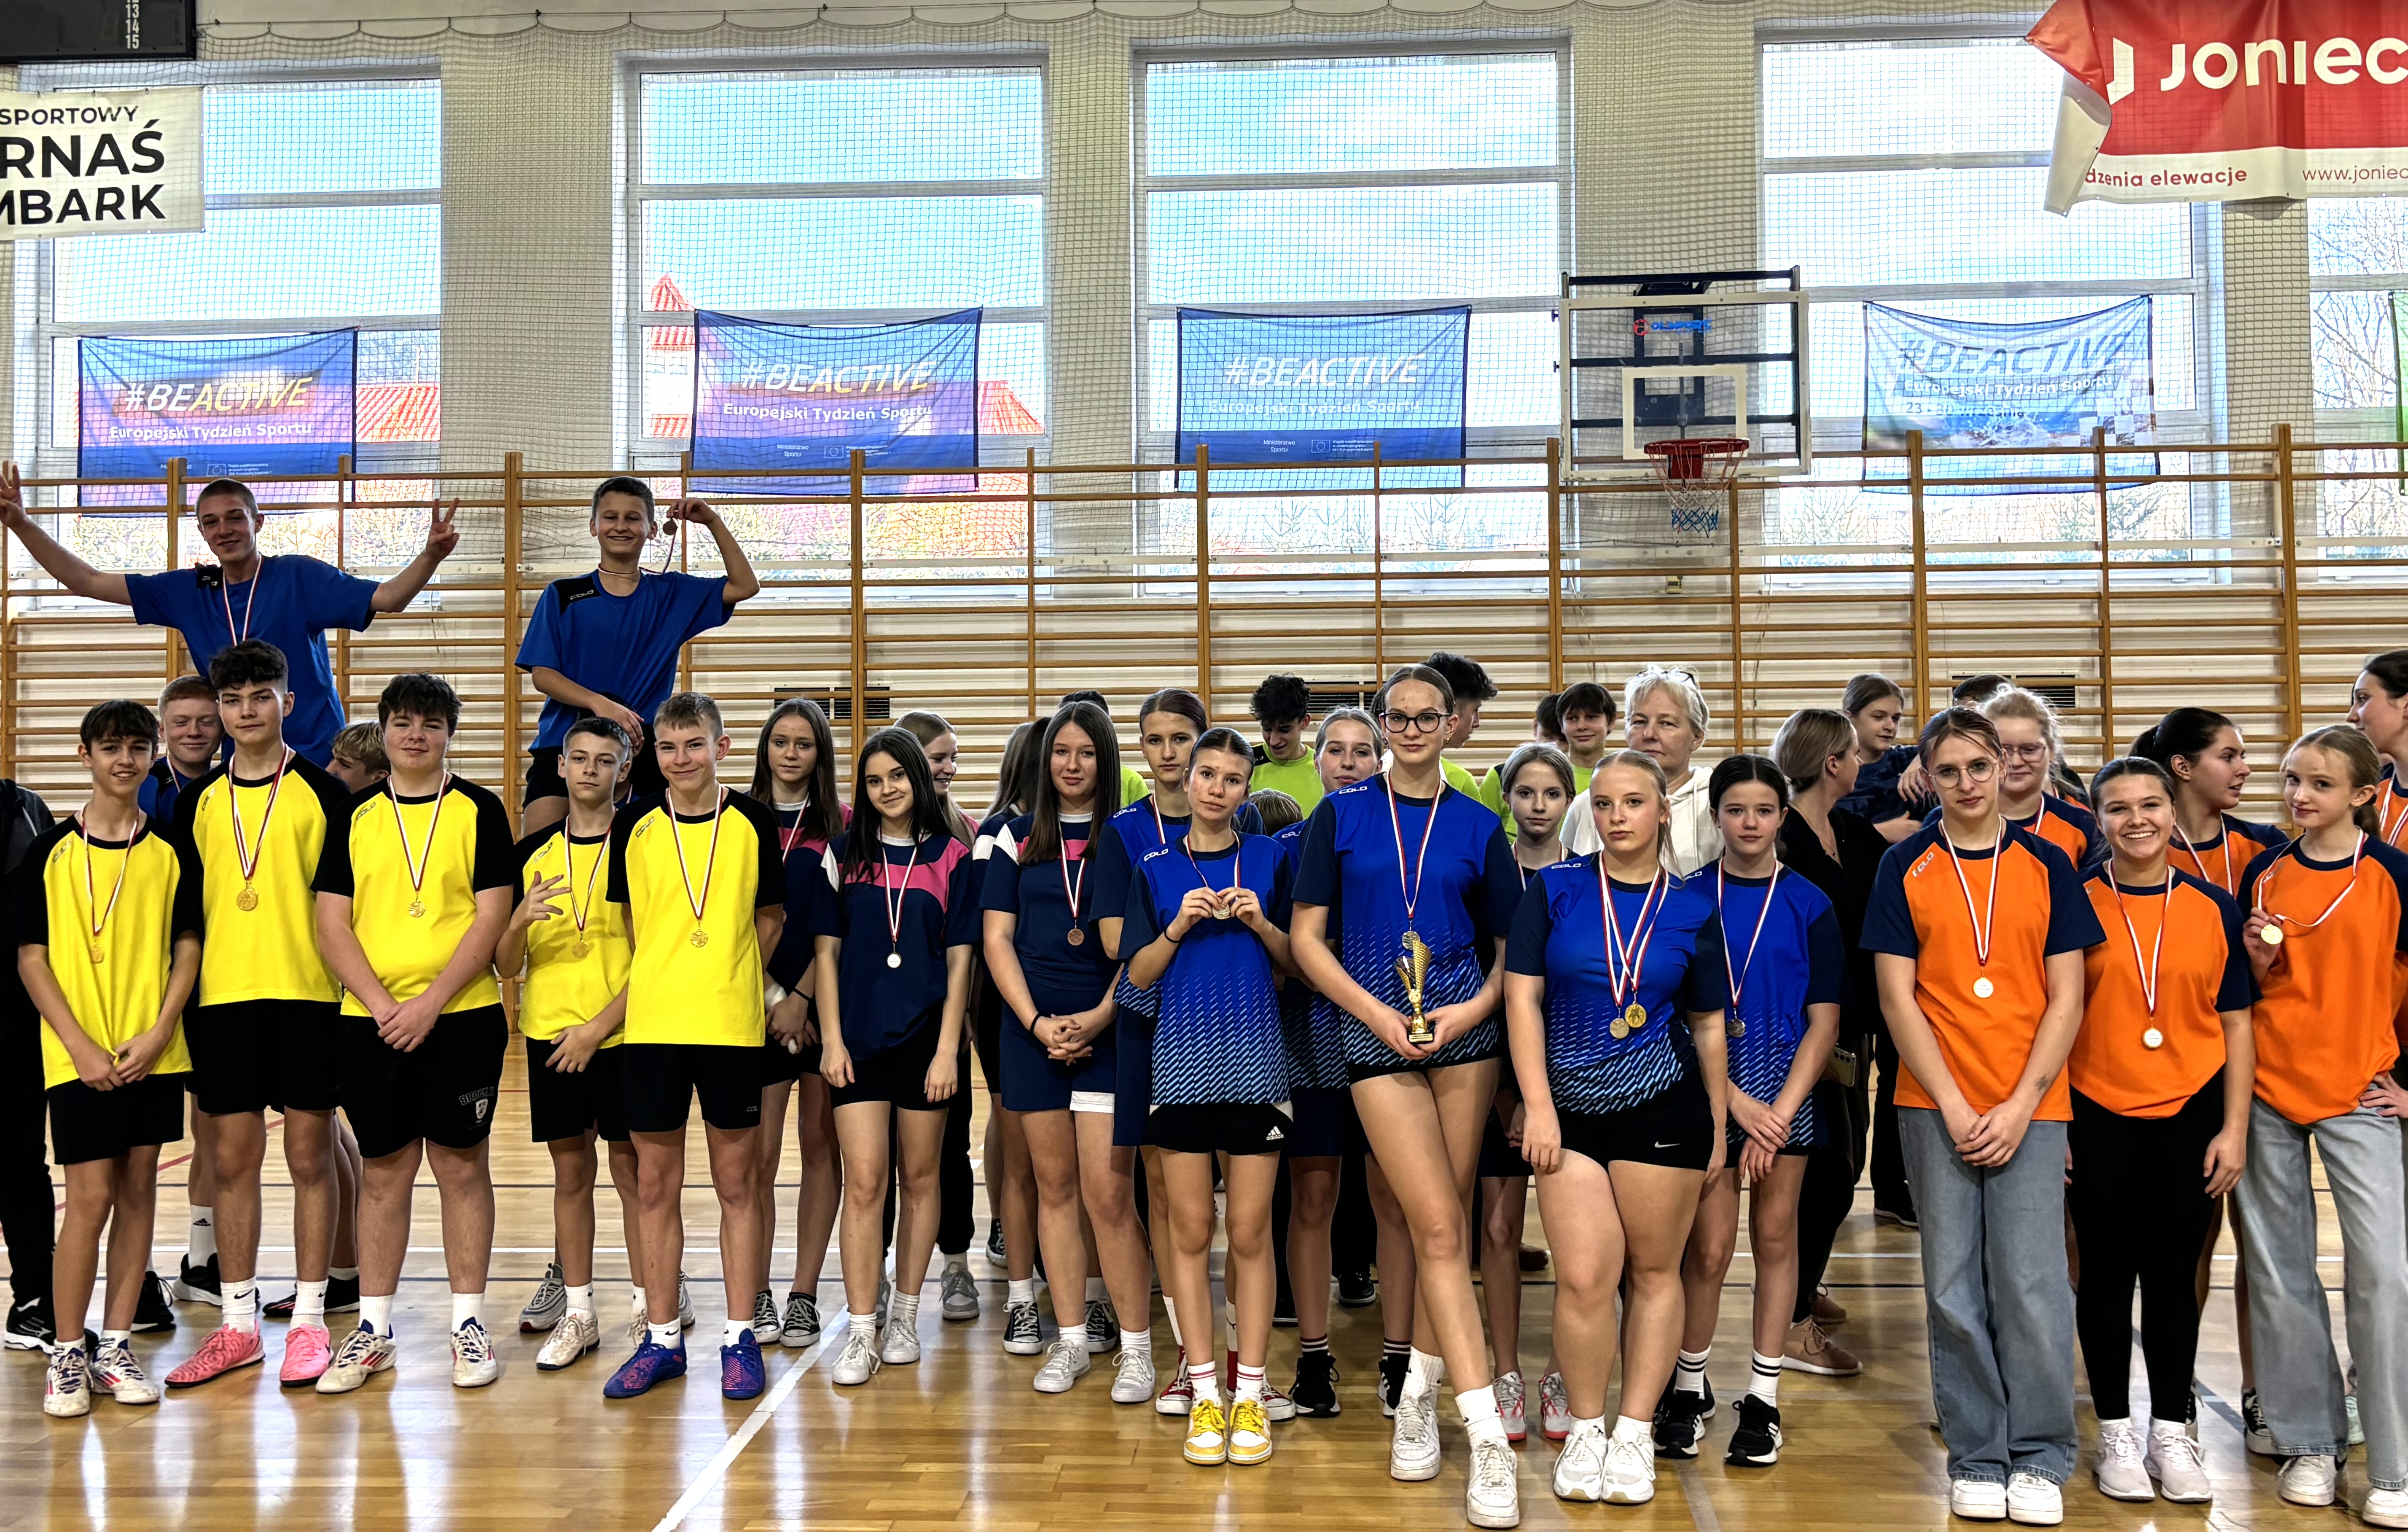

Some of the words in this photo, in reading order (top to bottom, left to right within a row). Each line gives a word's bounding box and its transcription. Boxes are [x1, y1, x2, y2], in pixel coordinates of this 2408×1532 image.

[125, 3, 140, 19] 13
[125, 19, 140, 34] 14
[125, 34, 140, 49] 15
[0, 105, 139, 126] SPORTOWY
[2150, 167, 2247, 186] elewacje
[740, 360, 938, 393] #BEACTIVE
[1223, 354, 1425, 387] #BEACTIVE
[125, 376, 313, 412] #BEACTIVE
[1904, 380, 1989, 398] Europejski
[1994, 380, 2056, 398] Tydzień
[2061, 376, 2112, 394] Sportu
[723, 402, 808, 421] Europejski
[812, 406, 876, 423] Tydzień
[880, 404, 932, 421] Sportu
[1208, 400, 1295, 417] Europejski
[1298, 399, 1361, 417] Tydzień
[1366, 398, 1420, 414] Sportu
[110, 425, 189, 441] Europejski
[191, 423, 252, 441] Tydzień
[256, 422, 312, 438] Sportu
[1338, 786, 1368, 795] COLO
[1113, 807, 1137, 818] COLO
[1282, 831, 1301, 839] COL
[1143, 848, 1169, 862] COLO
